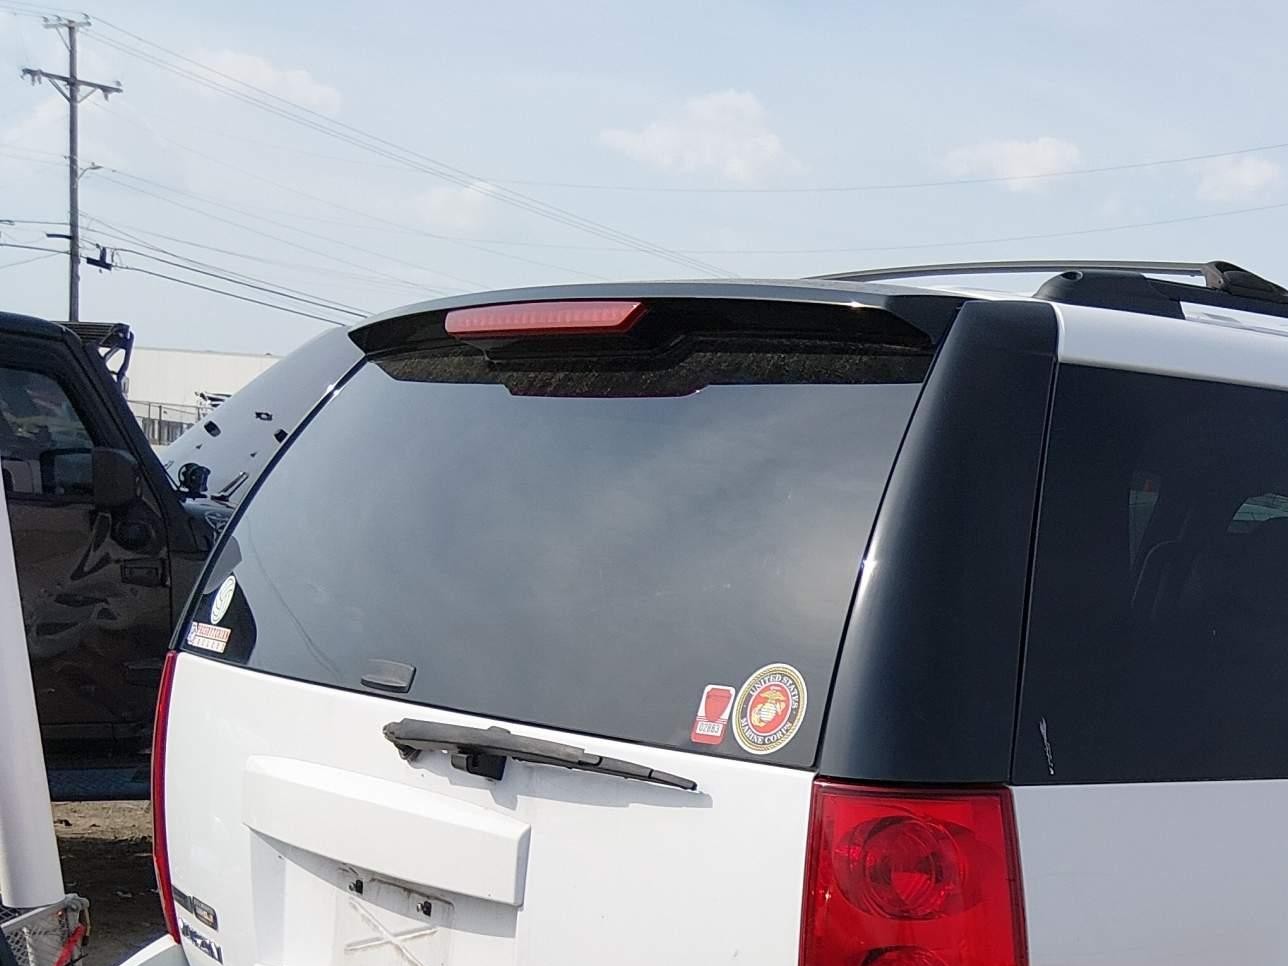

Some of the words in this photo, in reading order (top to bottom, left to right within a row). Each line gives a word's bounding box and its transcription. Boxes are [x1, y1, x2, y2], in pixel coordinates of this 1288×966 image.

[750, 673, 782, 696] UNITED
[781, 676, 800, 709] STATES
[740, 718, 764, 745] MARINE
[764, 721, 793, 745] CORPS
